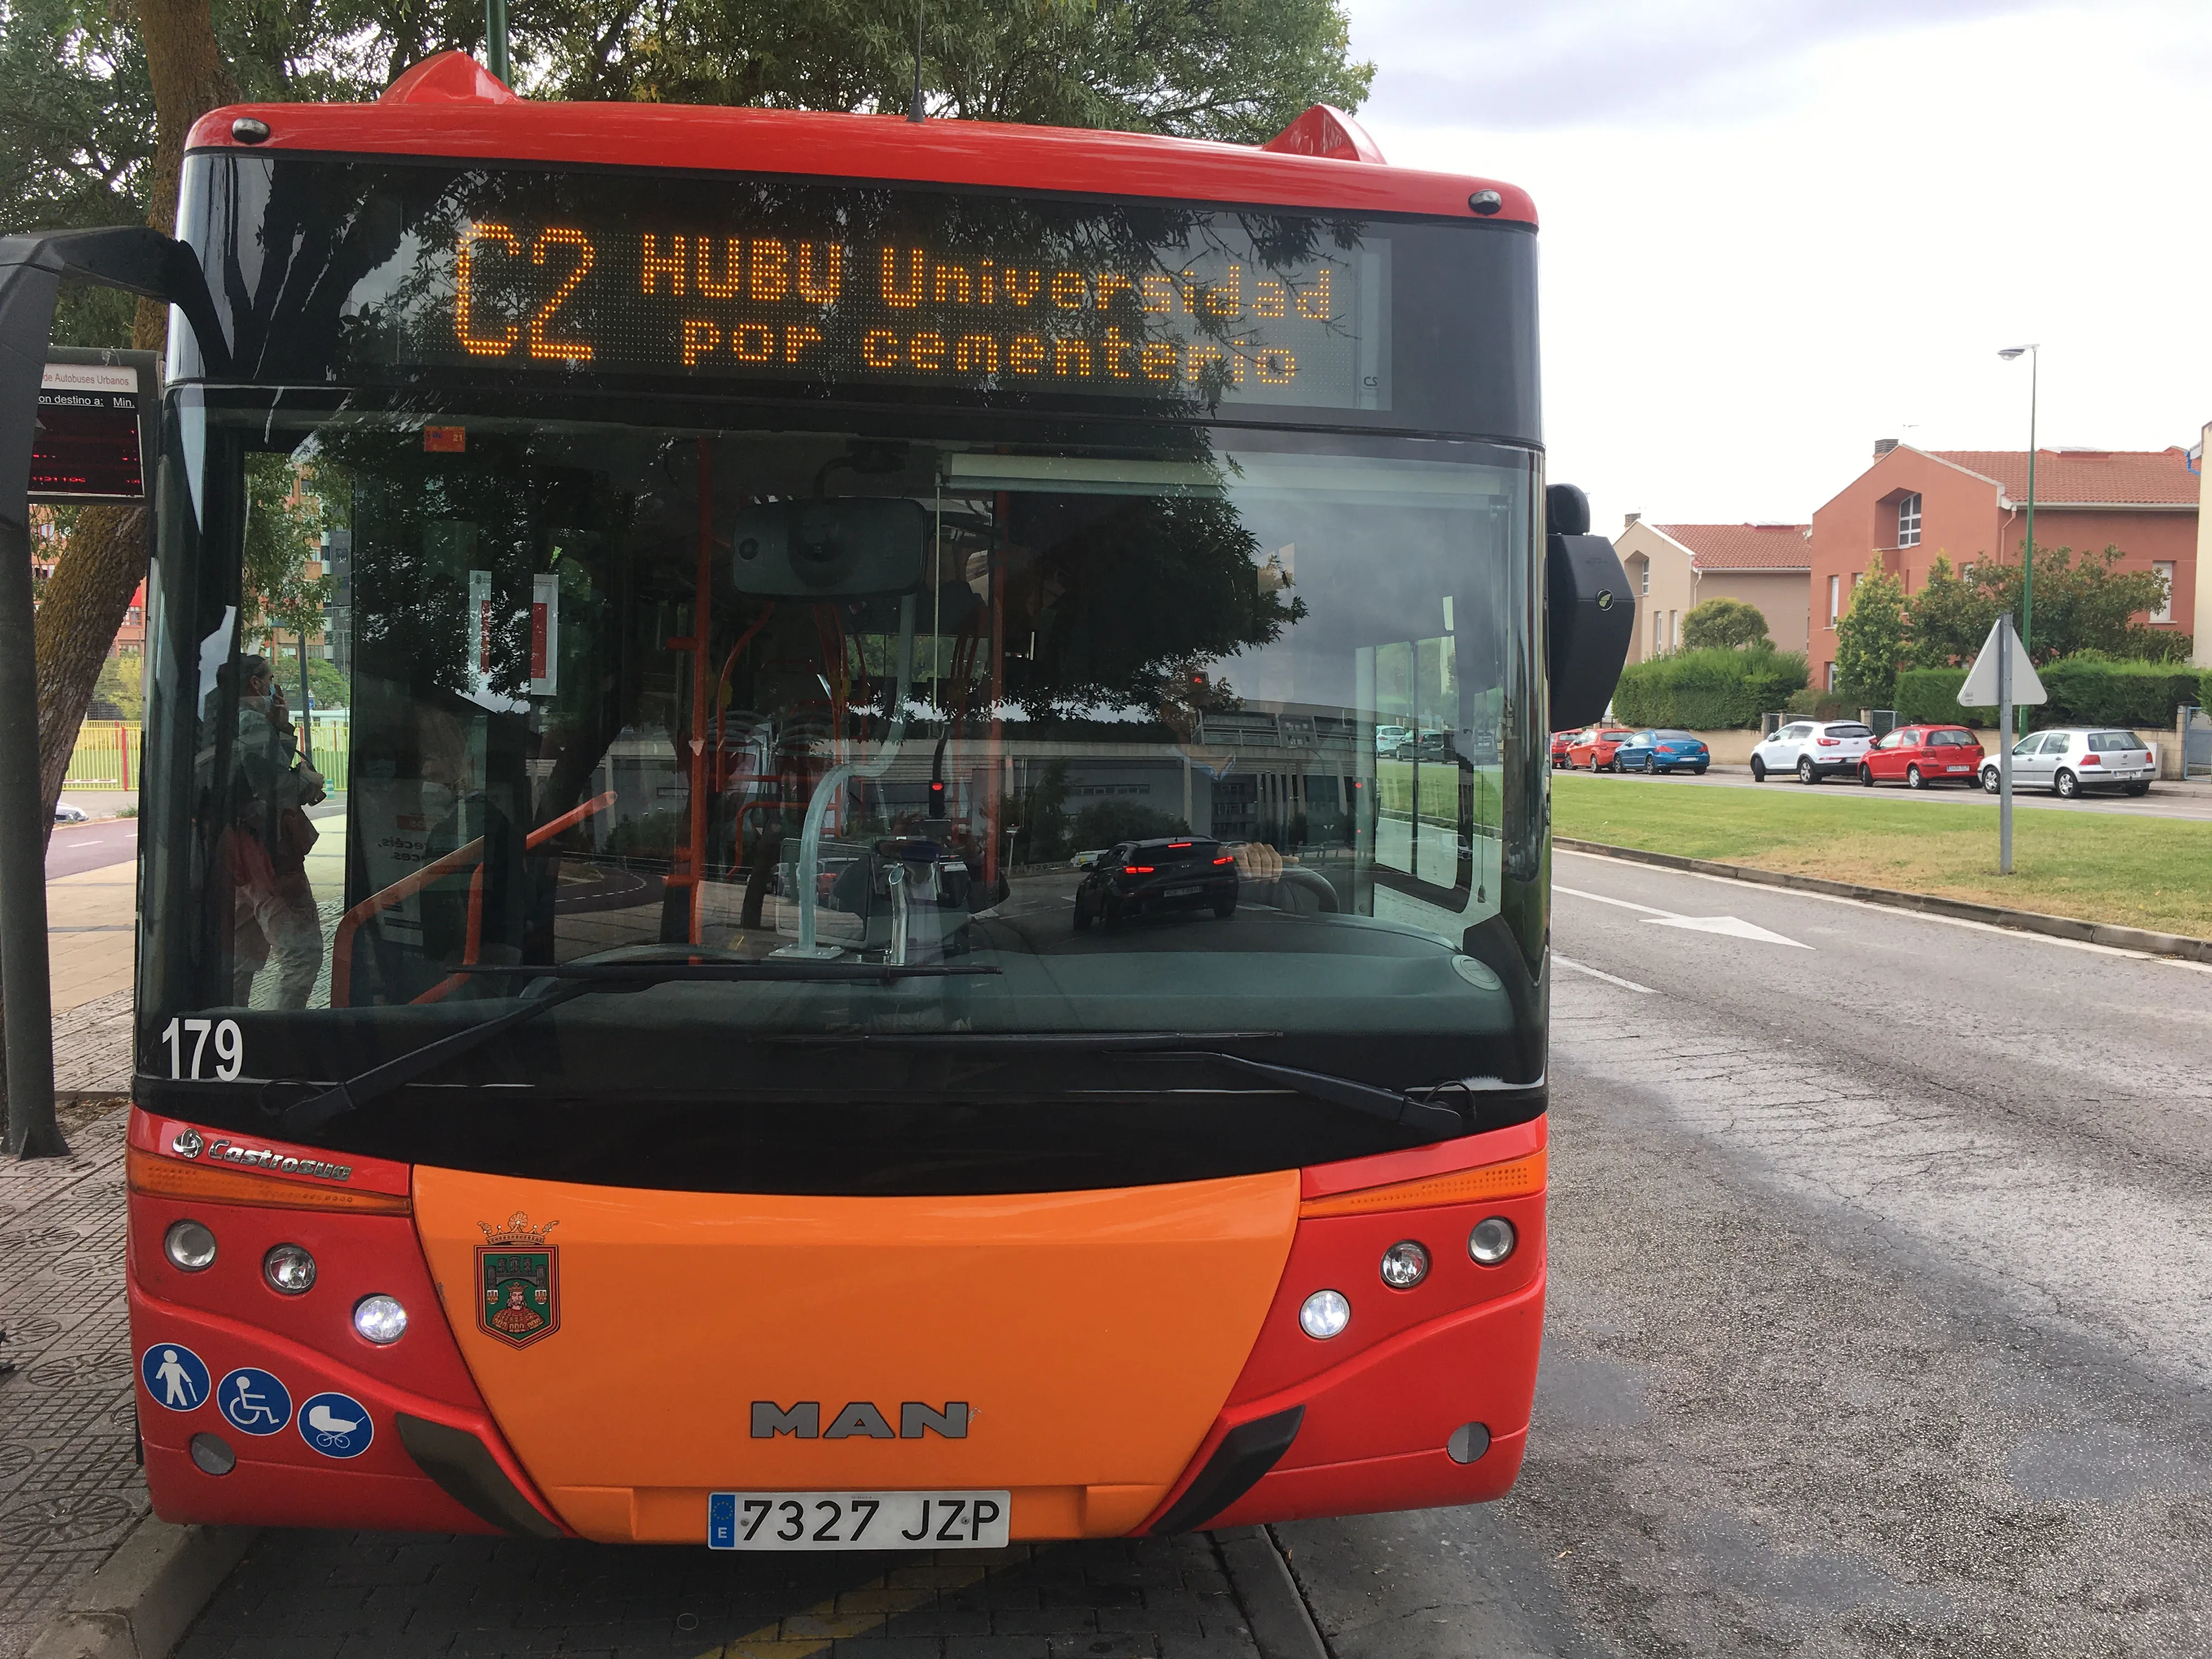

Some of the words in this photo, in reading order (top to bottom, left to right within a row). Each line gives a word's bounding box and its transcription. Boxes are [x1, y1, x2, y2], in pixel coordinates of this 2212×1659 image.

[457, 223, 592, 360] C2
[643, 233, 841, 303] HUBU
[881, 246, 1331, 320] Universidad
[684, 319, 822, 365] por
[863, 327, 1295, 385] cementerio
[43, 374, 52, 382] de
[55, 374, 94, 384] Autobuses
[97, 375, 129, 386] Urbanos
[54, 395, 91, 405] destino
[113, 397, 135, 408] Min.
[453, 433, 462, 442] 21
[162, 1017, 243, 1081] 179
[207, 1139, 354, 1181] Castrosua
[751, 1401, 969, 1438] MAN
[718, 1527, 727, 1539] E
[743, 1499, 880, 1542] 7327
[901, 1499, 1000, 1541] JZP
